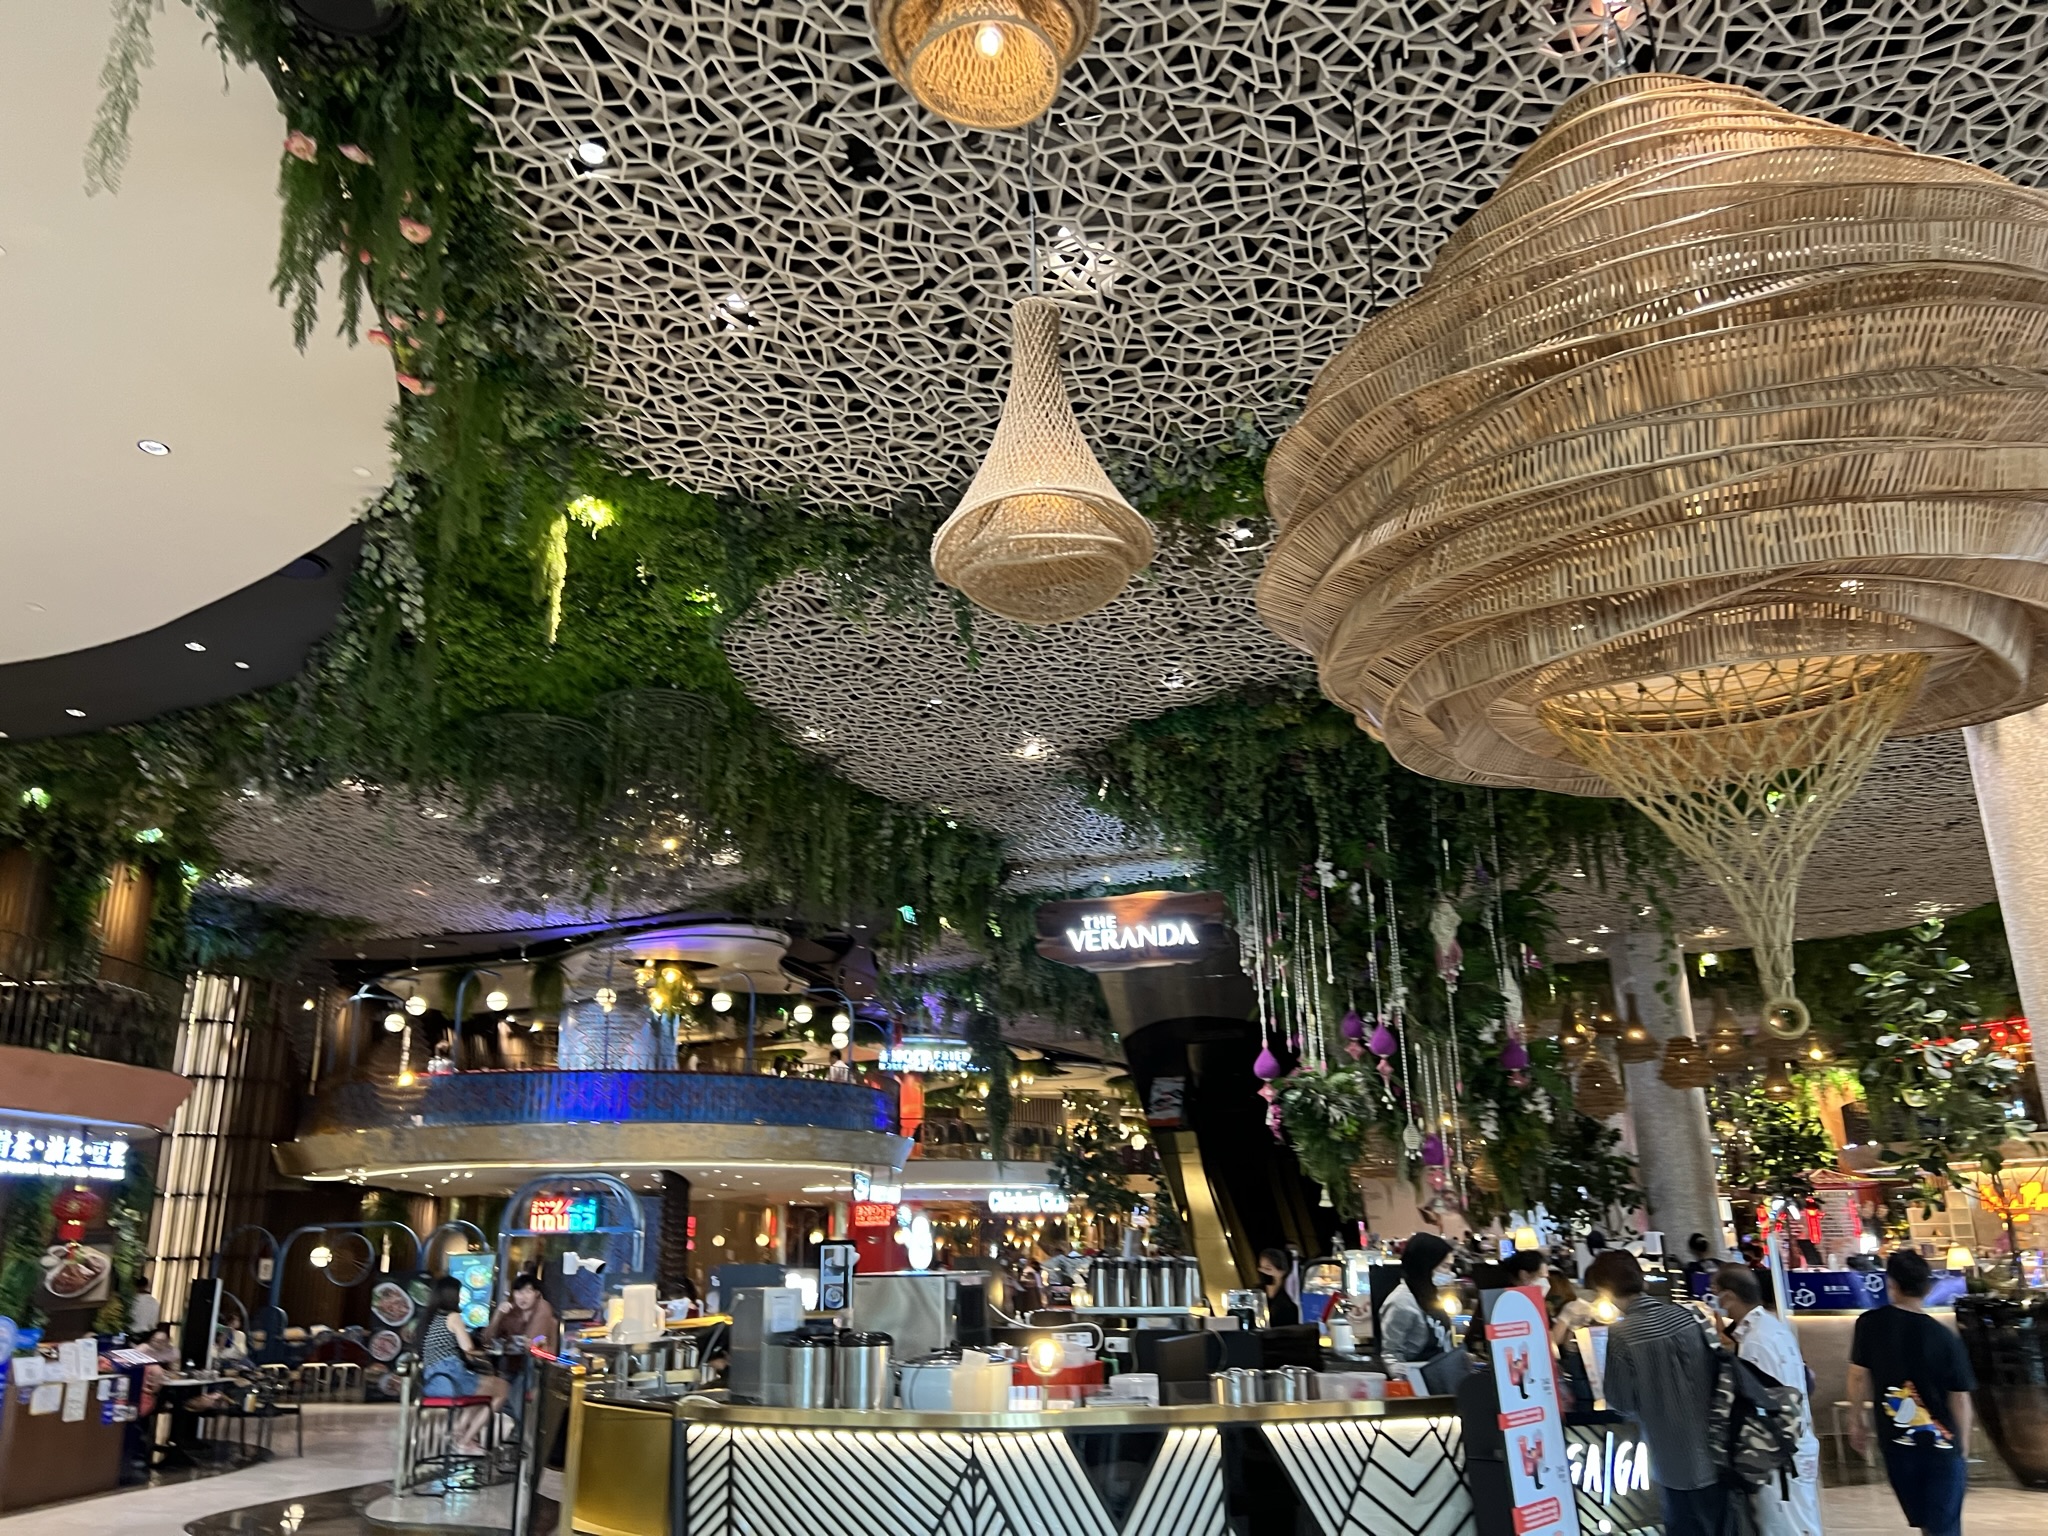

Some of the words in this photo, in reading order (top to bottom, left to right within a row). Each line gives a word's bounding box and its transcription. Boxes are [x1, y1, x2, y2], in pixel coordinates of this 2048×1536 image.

[1081, 915, 1117, 930] THE
[1065, 920, 1200, 953] VERANDA
[933, 1050, 972, 1062] FRIED
